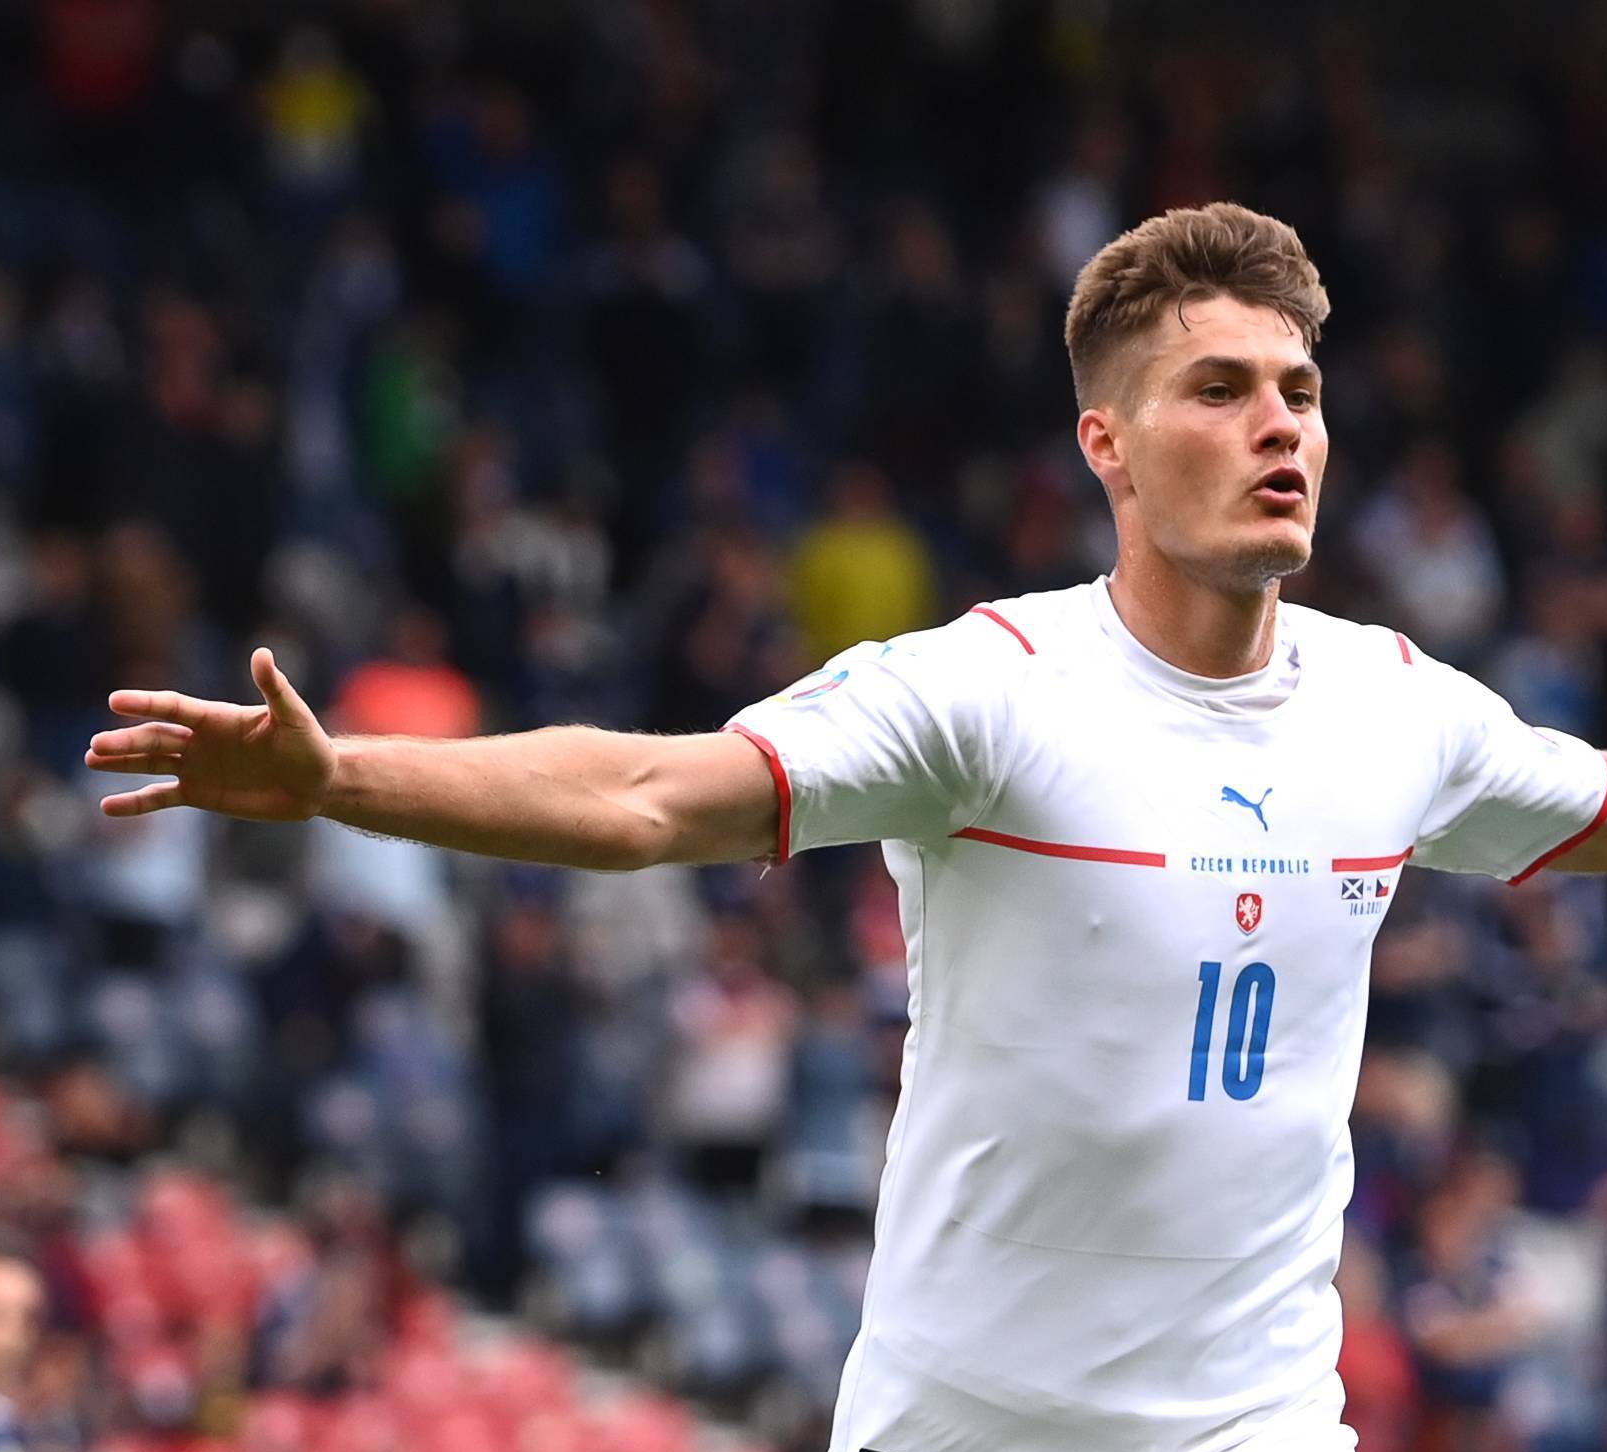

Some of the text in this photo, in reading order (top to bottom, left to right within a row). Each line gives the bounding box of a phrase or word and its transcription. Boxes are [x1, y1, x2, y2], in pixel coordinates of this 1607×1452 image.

[1191, 857, 1309, 874] CZECH REPUBLIC
[1188, 961, 1275, 1101] 10
